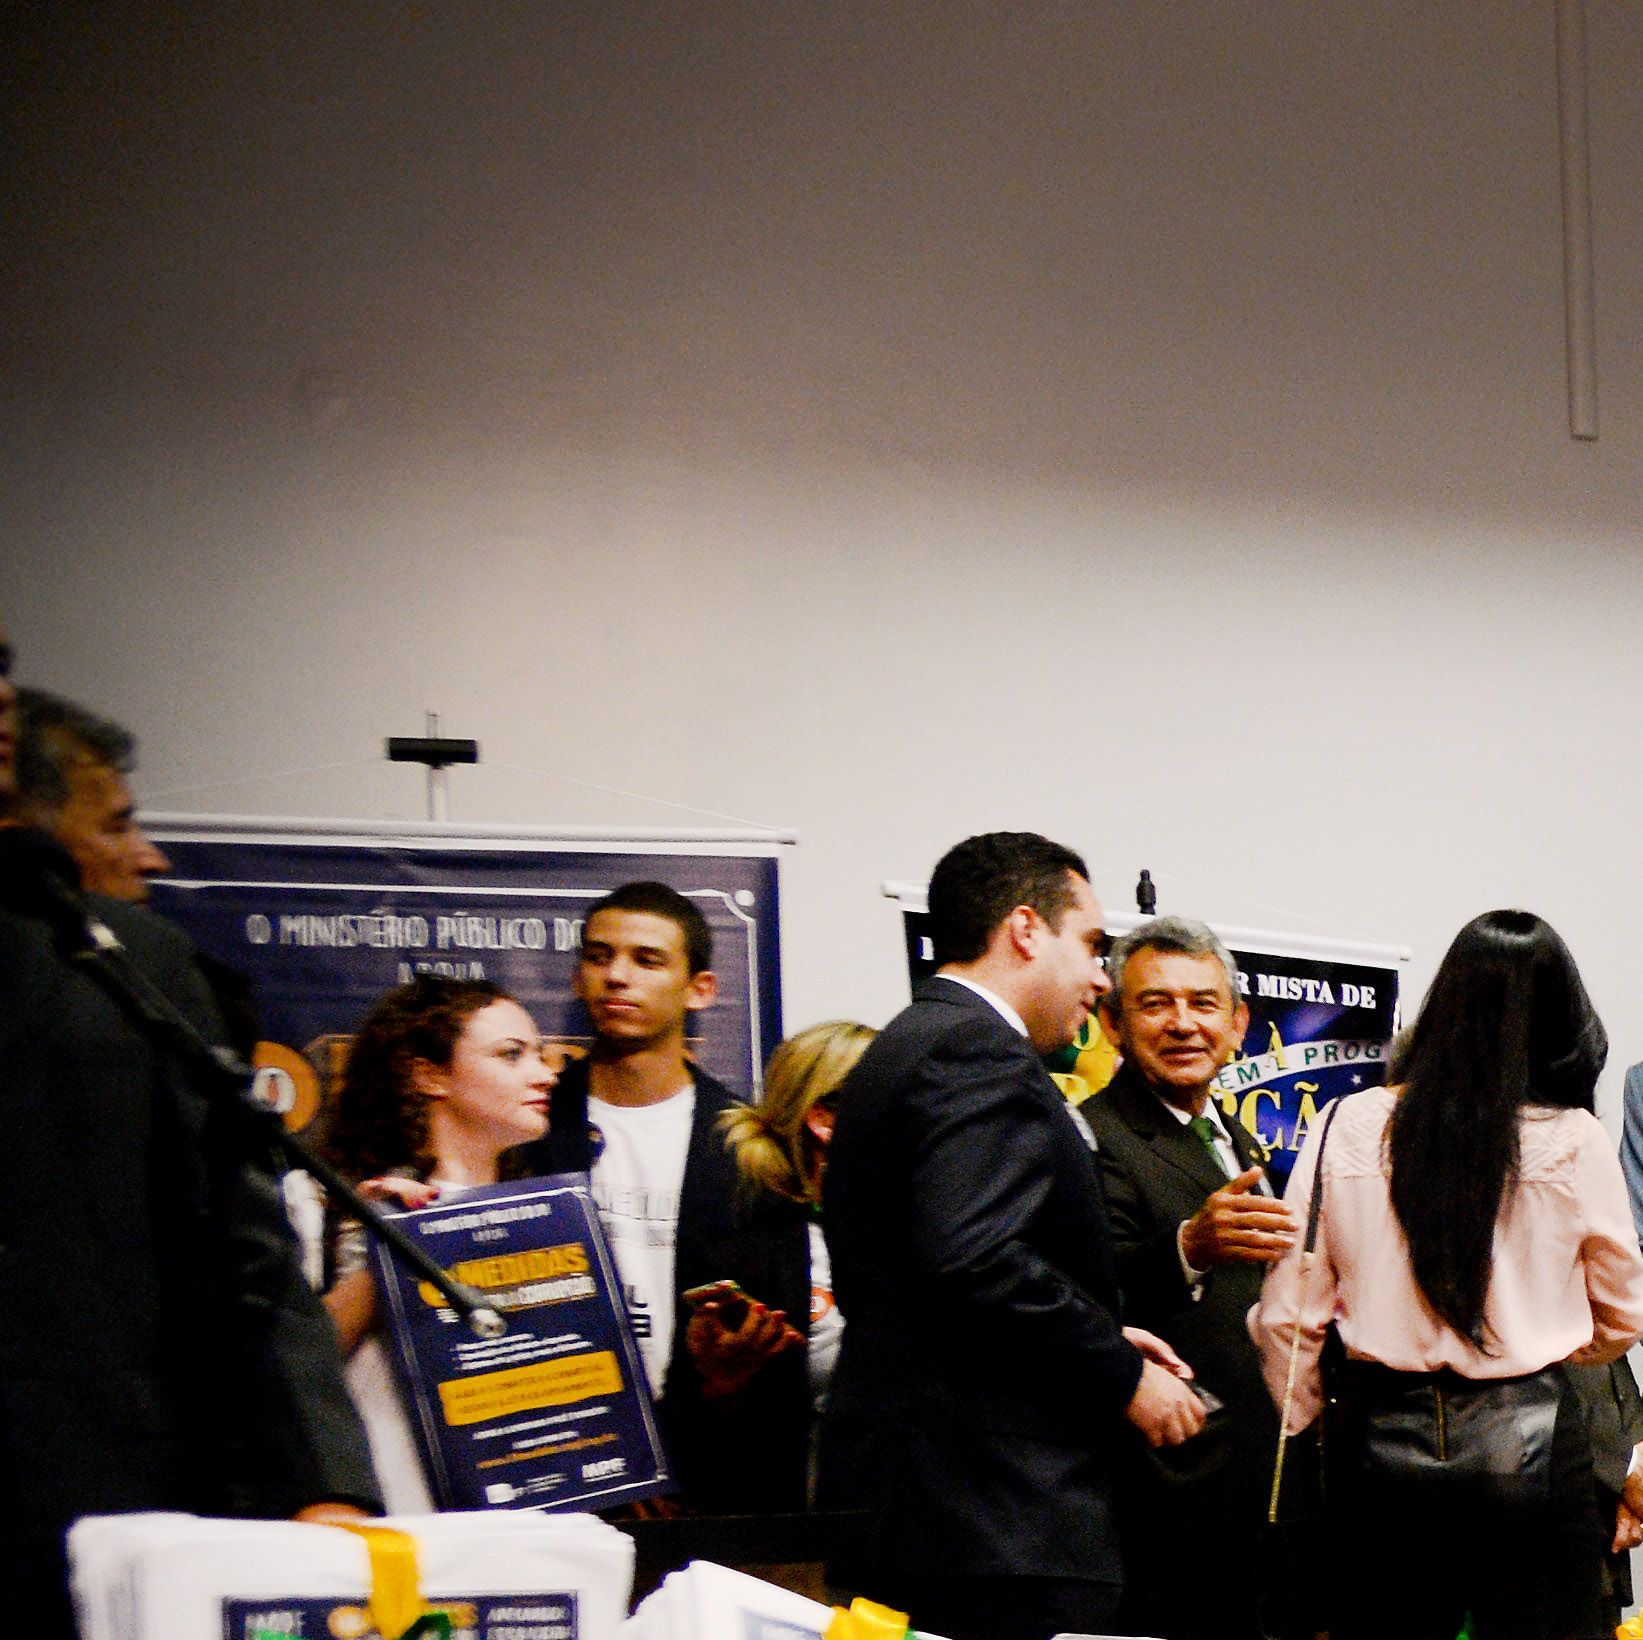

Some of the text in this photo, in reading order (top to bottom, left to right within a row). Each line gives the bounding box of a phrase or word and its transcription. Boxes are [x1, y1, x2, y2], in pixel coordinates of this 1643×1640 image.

[1256, 974, 1332, 1004] MISTA
[1340, 983, 1377, 1009] DE
[1304, 1041, 1384, 1066] PROG
